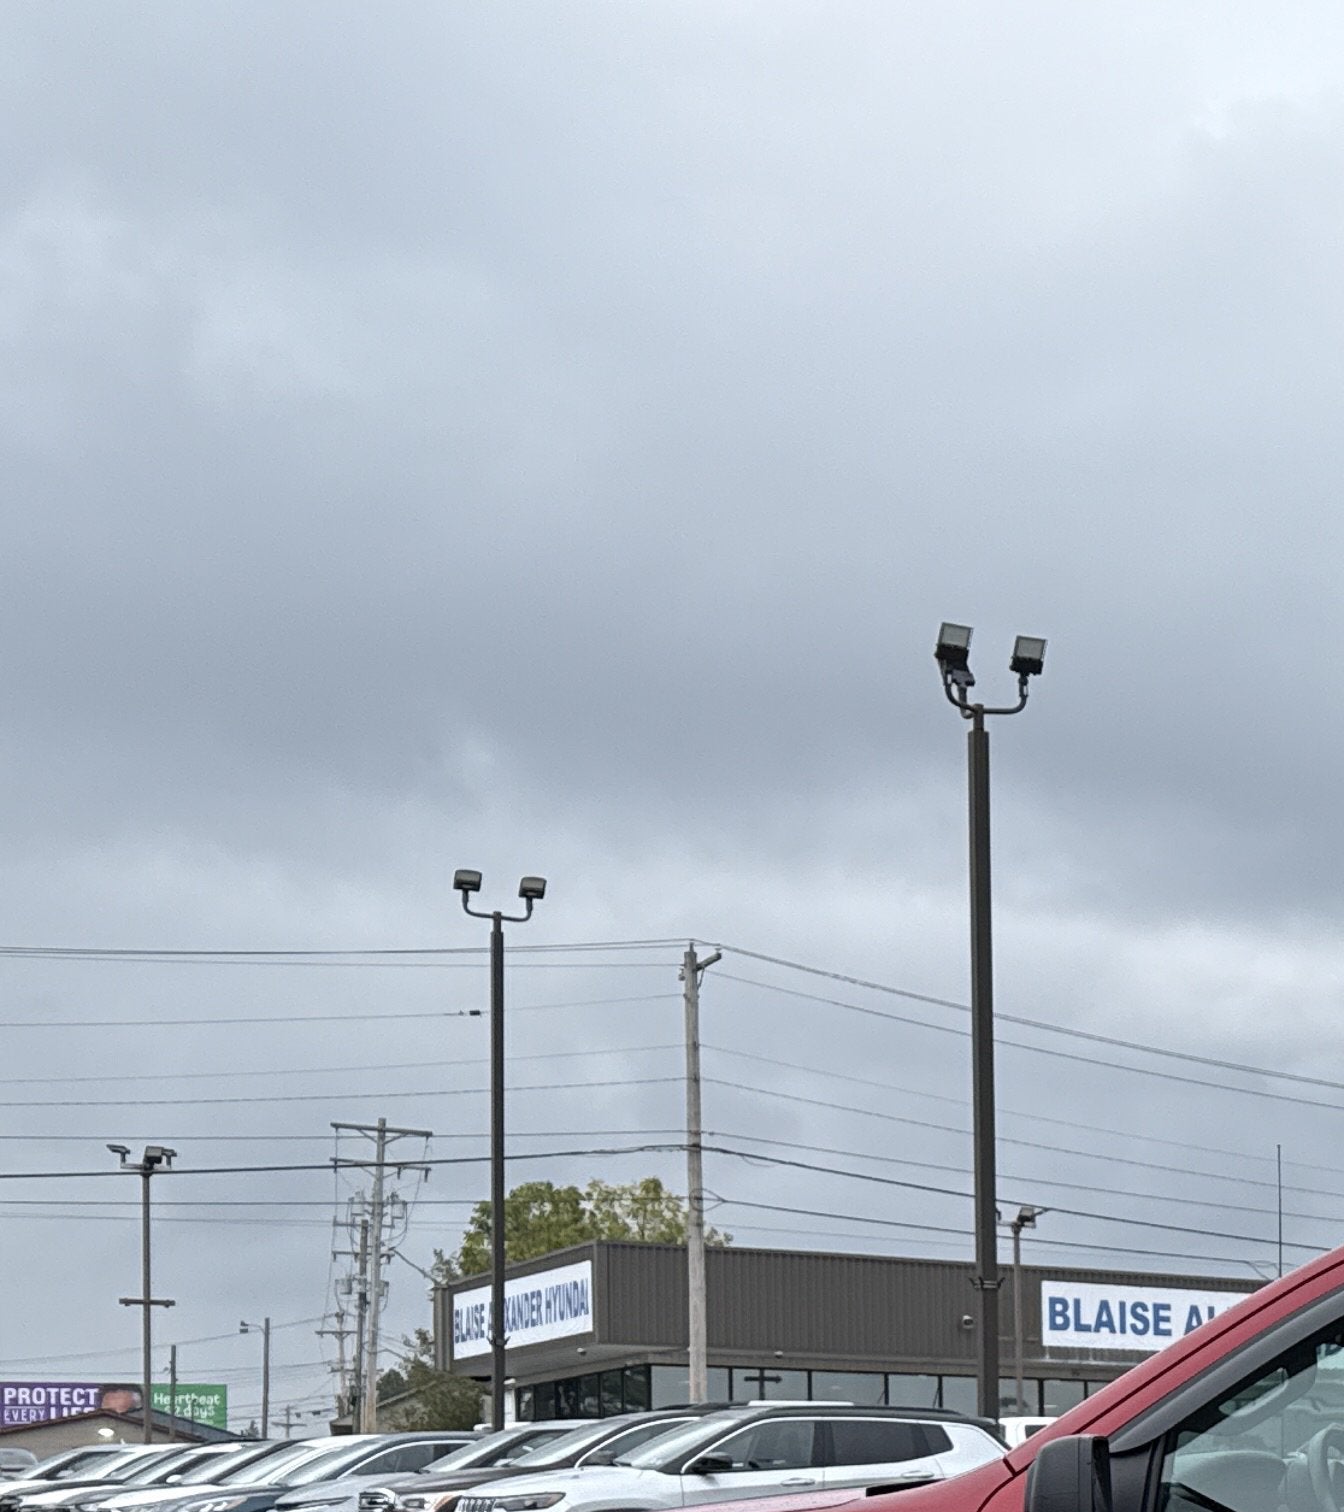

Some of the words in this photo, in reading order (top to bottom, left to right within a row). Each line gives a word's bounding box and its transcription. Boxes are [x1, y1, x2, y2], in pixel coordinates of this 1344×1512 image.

[455, 1303, 485, 1344] BLAISE
[545, 1278, 589, 1325] HYUNDAI
[1048, 1296, 1172, 1337] BLAISE
[4, 1387, 99, 1406] PROTECT
[4, 1408, 45, 1422] EVERY
